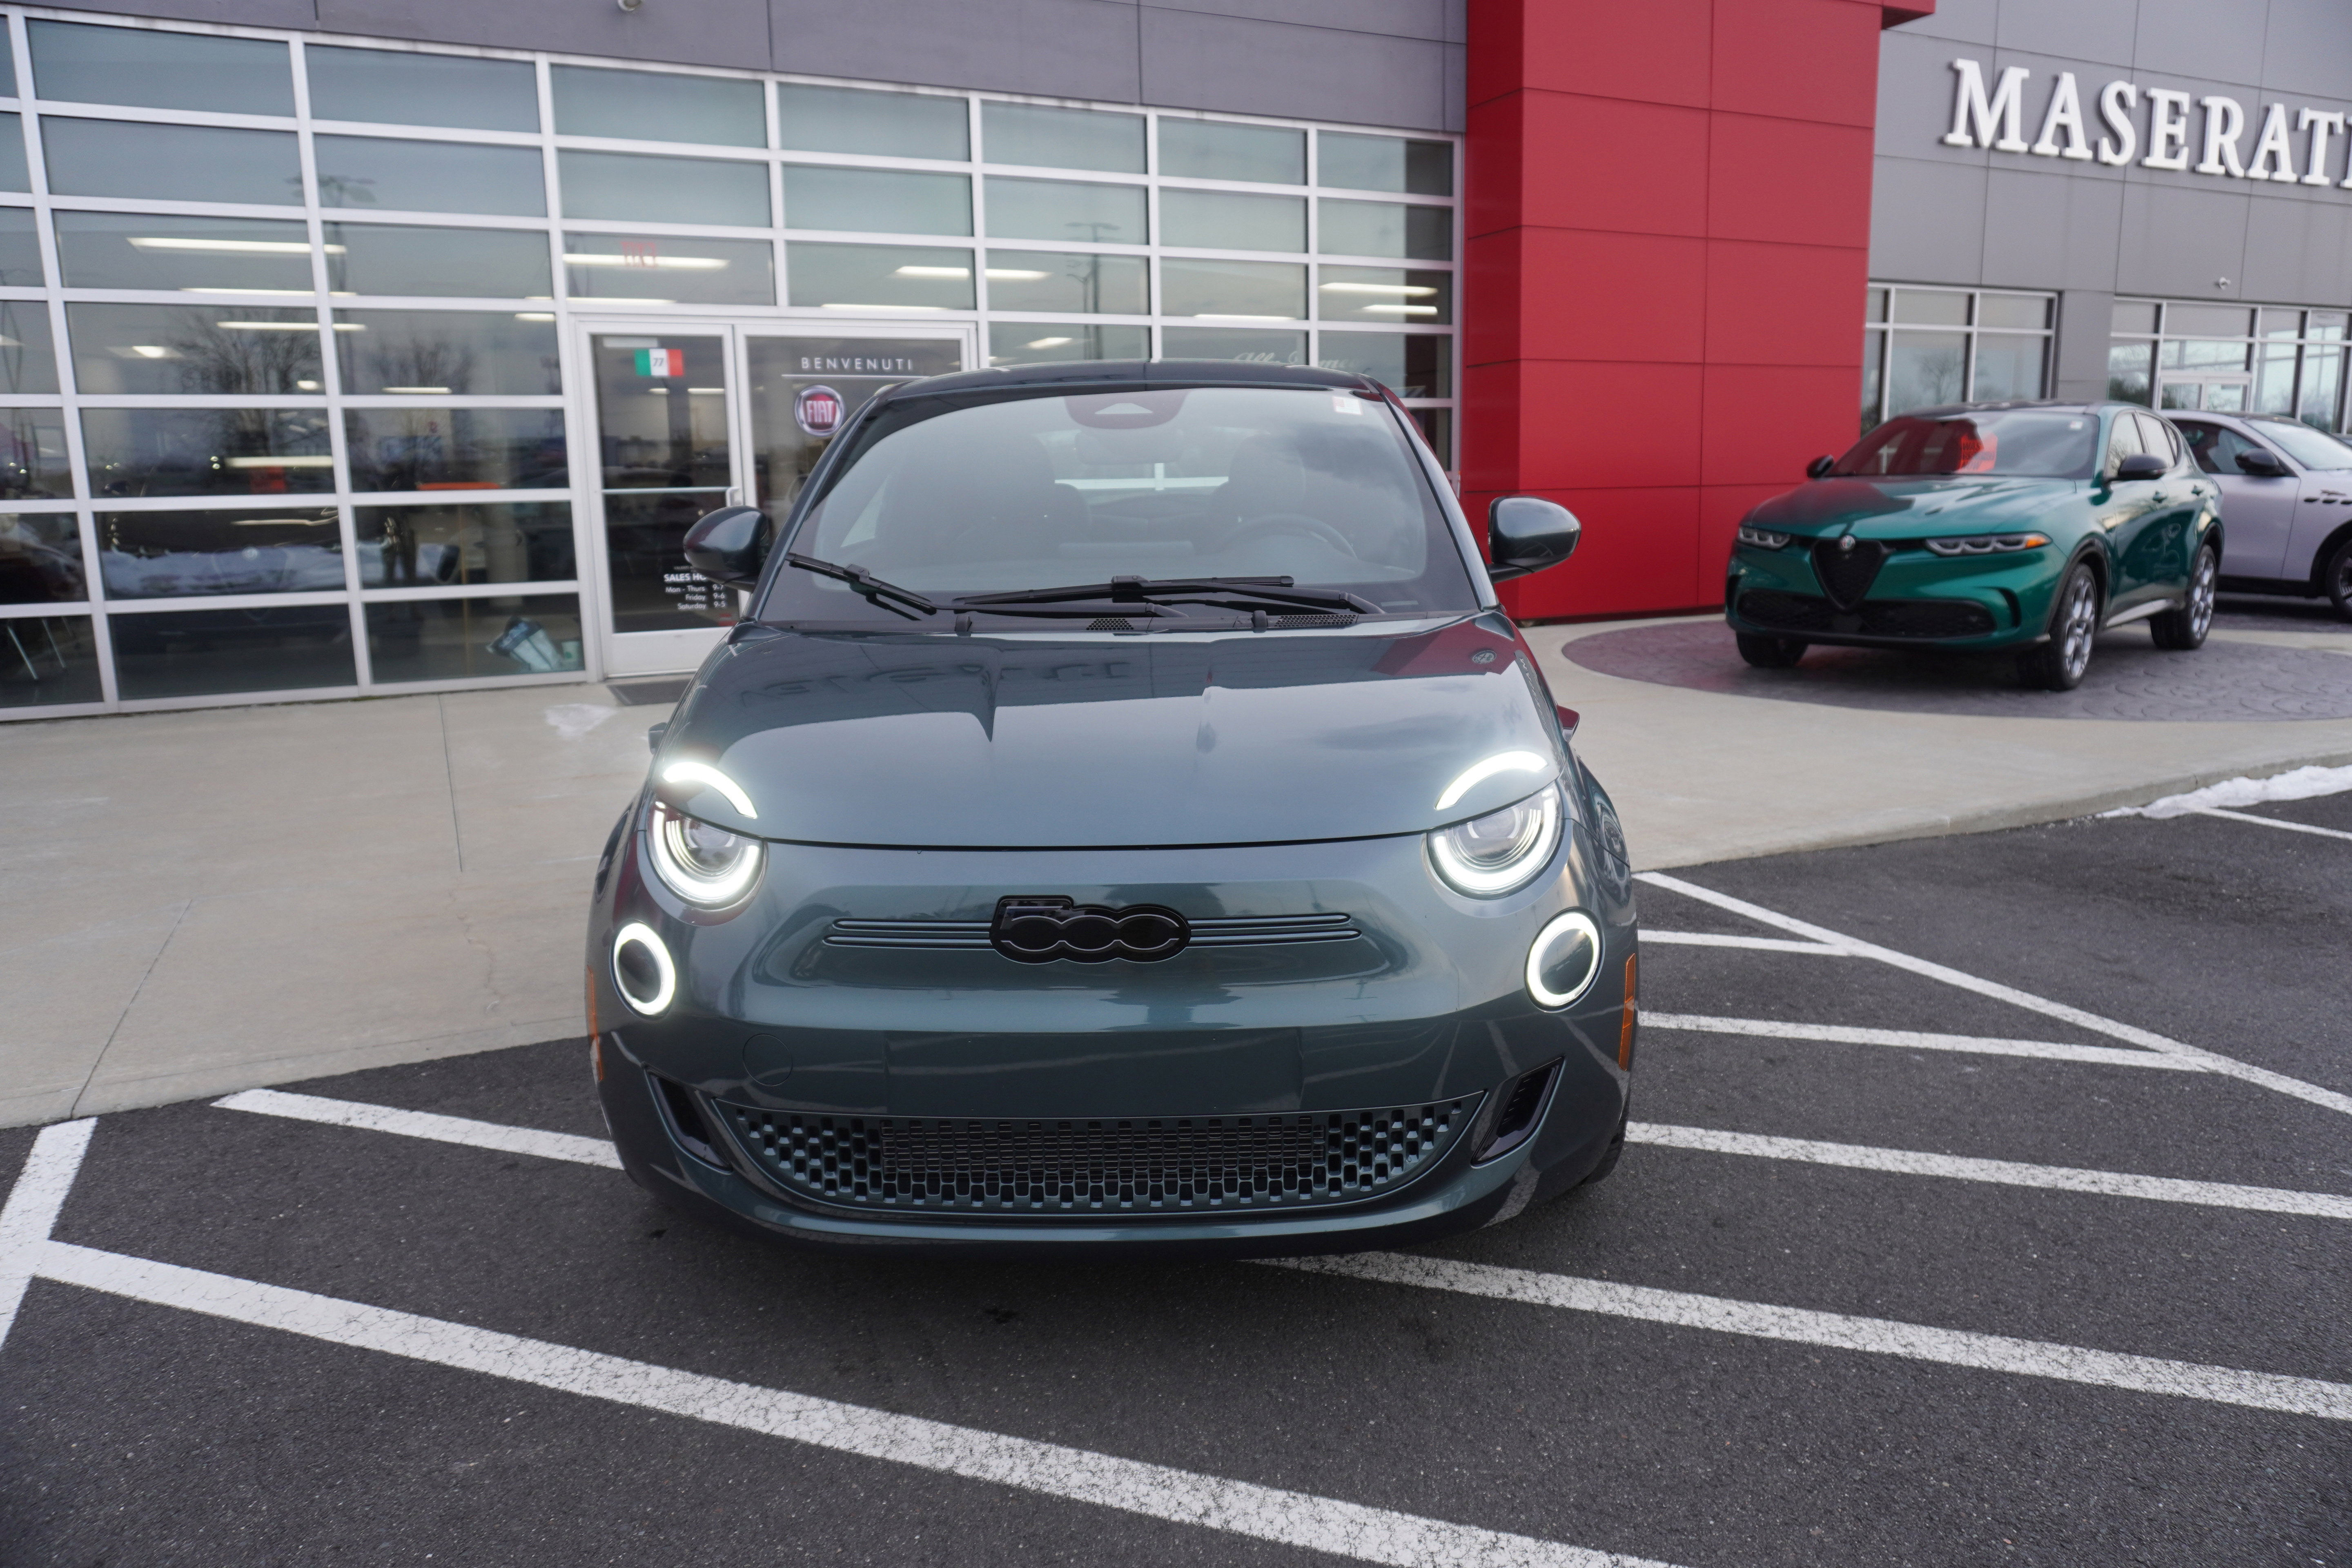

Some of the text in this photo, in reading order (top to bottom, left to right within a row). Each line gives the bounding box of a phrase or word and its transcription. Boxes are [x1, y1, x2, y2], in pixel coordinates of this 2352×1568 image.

[801, 357, 913, 370] BENVENUTI
[806, 400, 834, 422] FIAT
[664, 573, 690, 582] SALES
[991, 897, 1189, 962] 500
